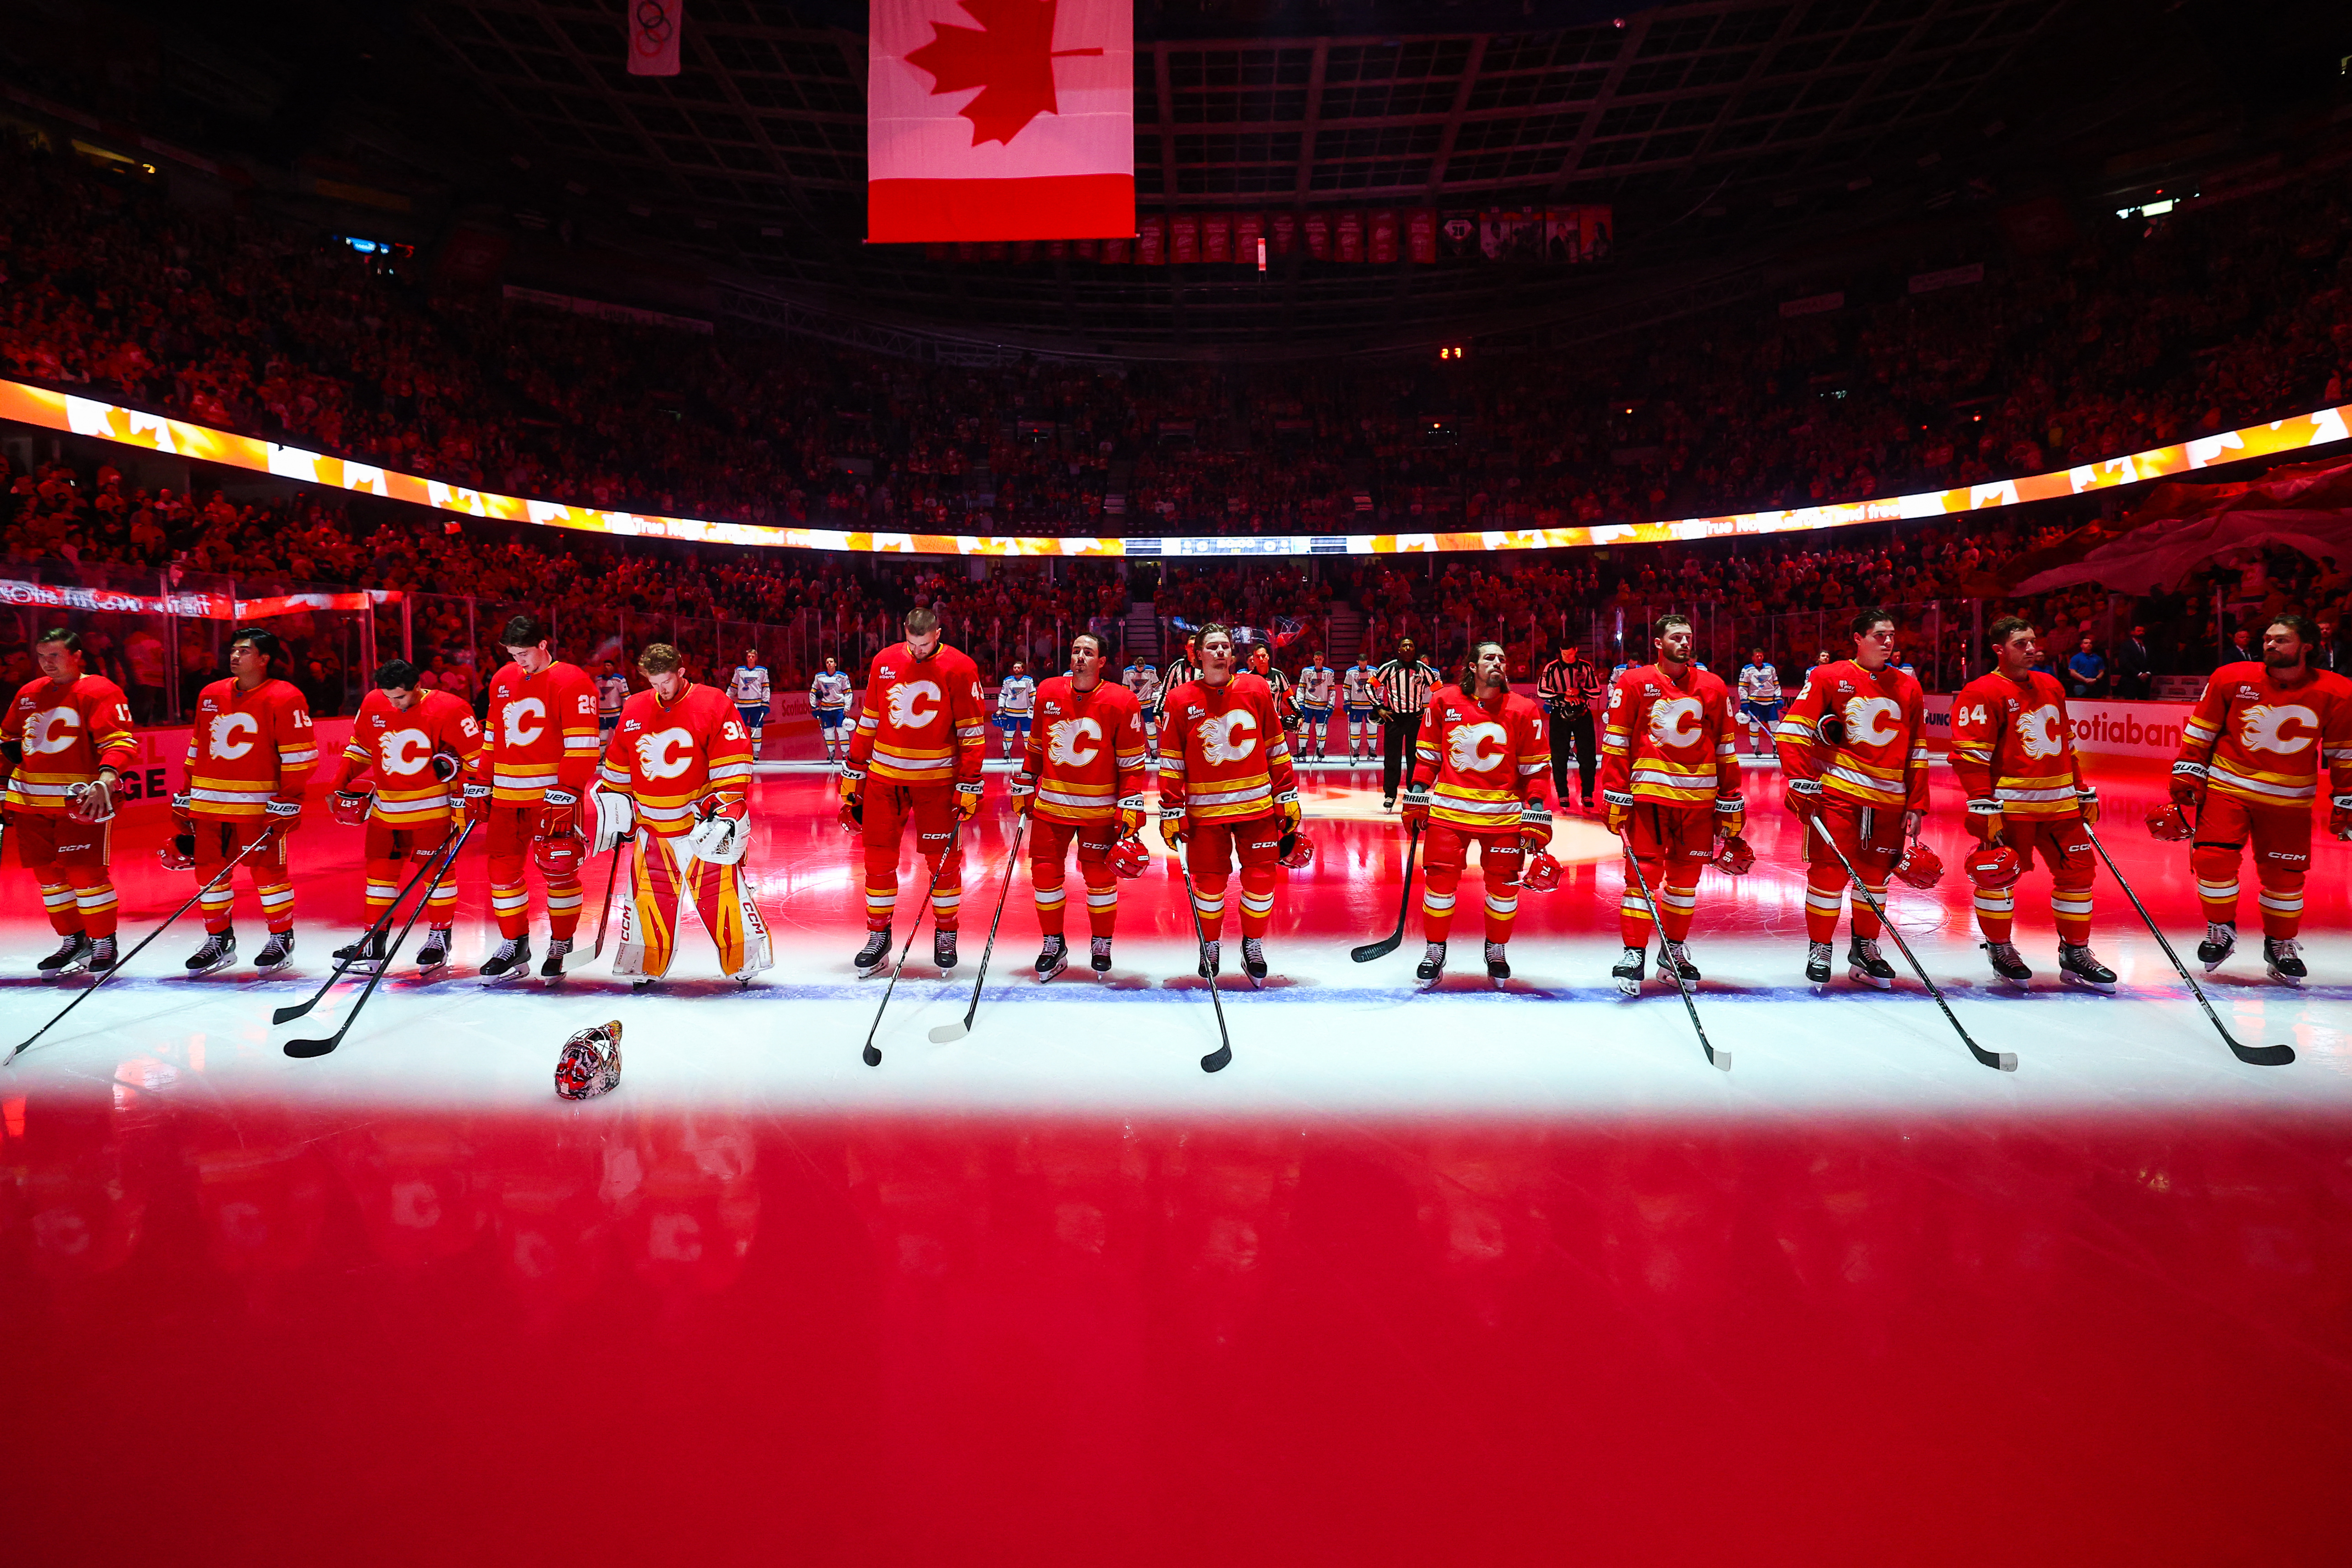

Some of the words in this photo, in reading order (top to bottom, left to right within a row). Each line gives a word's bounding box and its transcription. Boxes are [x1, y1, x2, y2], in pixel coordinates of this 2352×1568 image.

[115, 703, 132, 722] 17
[502, 697, 546, 748] C
[578, 695, 596, 715] 29
[886, 679, 941, 729] C
[1130, 711, 1141, 732] 4
[1648, 696, 1704, 748] C
[1843, 695, 1902, 747] C
[1958, 704, 1987, 727] 94
[21, 706, 81, 756] C
[209, 712, 258, 760] C
[460, 715, 480, 738] 2
[723, 720, 747, 741] 32
[1047, 716, 1103, 767] C
[1197, 709, 1257, 766] C
[2016, 703, 2062, 760] C
[2239, 703, 2319, 754] C
[378, 727, 432, 776] C
[635, 727, 694, 782] C
[1447, 721, 1508, 773] C
[58, 844, 91, 852] CCM
[1082, 841, 1113, 851] CCM
[1116, 858, 1125, 868] 44
[1251, 841, 1278, 849] CCM
[2268, 851, 2307, 862] CCM
[1540, 865, 1551, 877] 70
[621, 905, 632, 942] CCM
[743, 902, 765, 935] CCM
